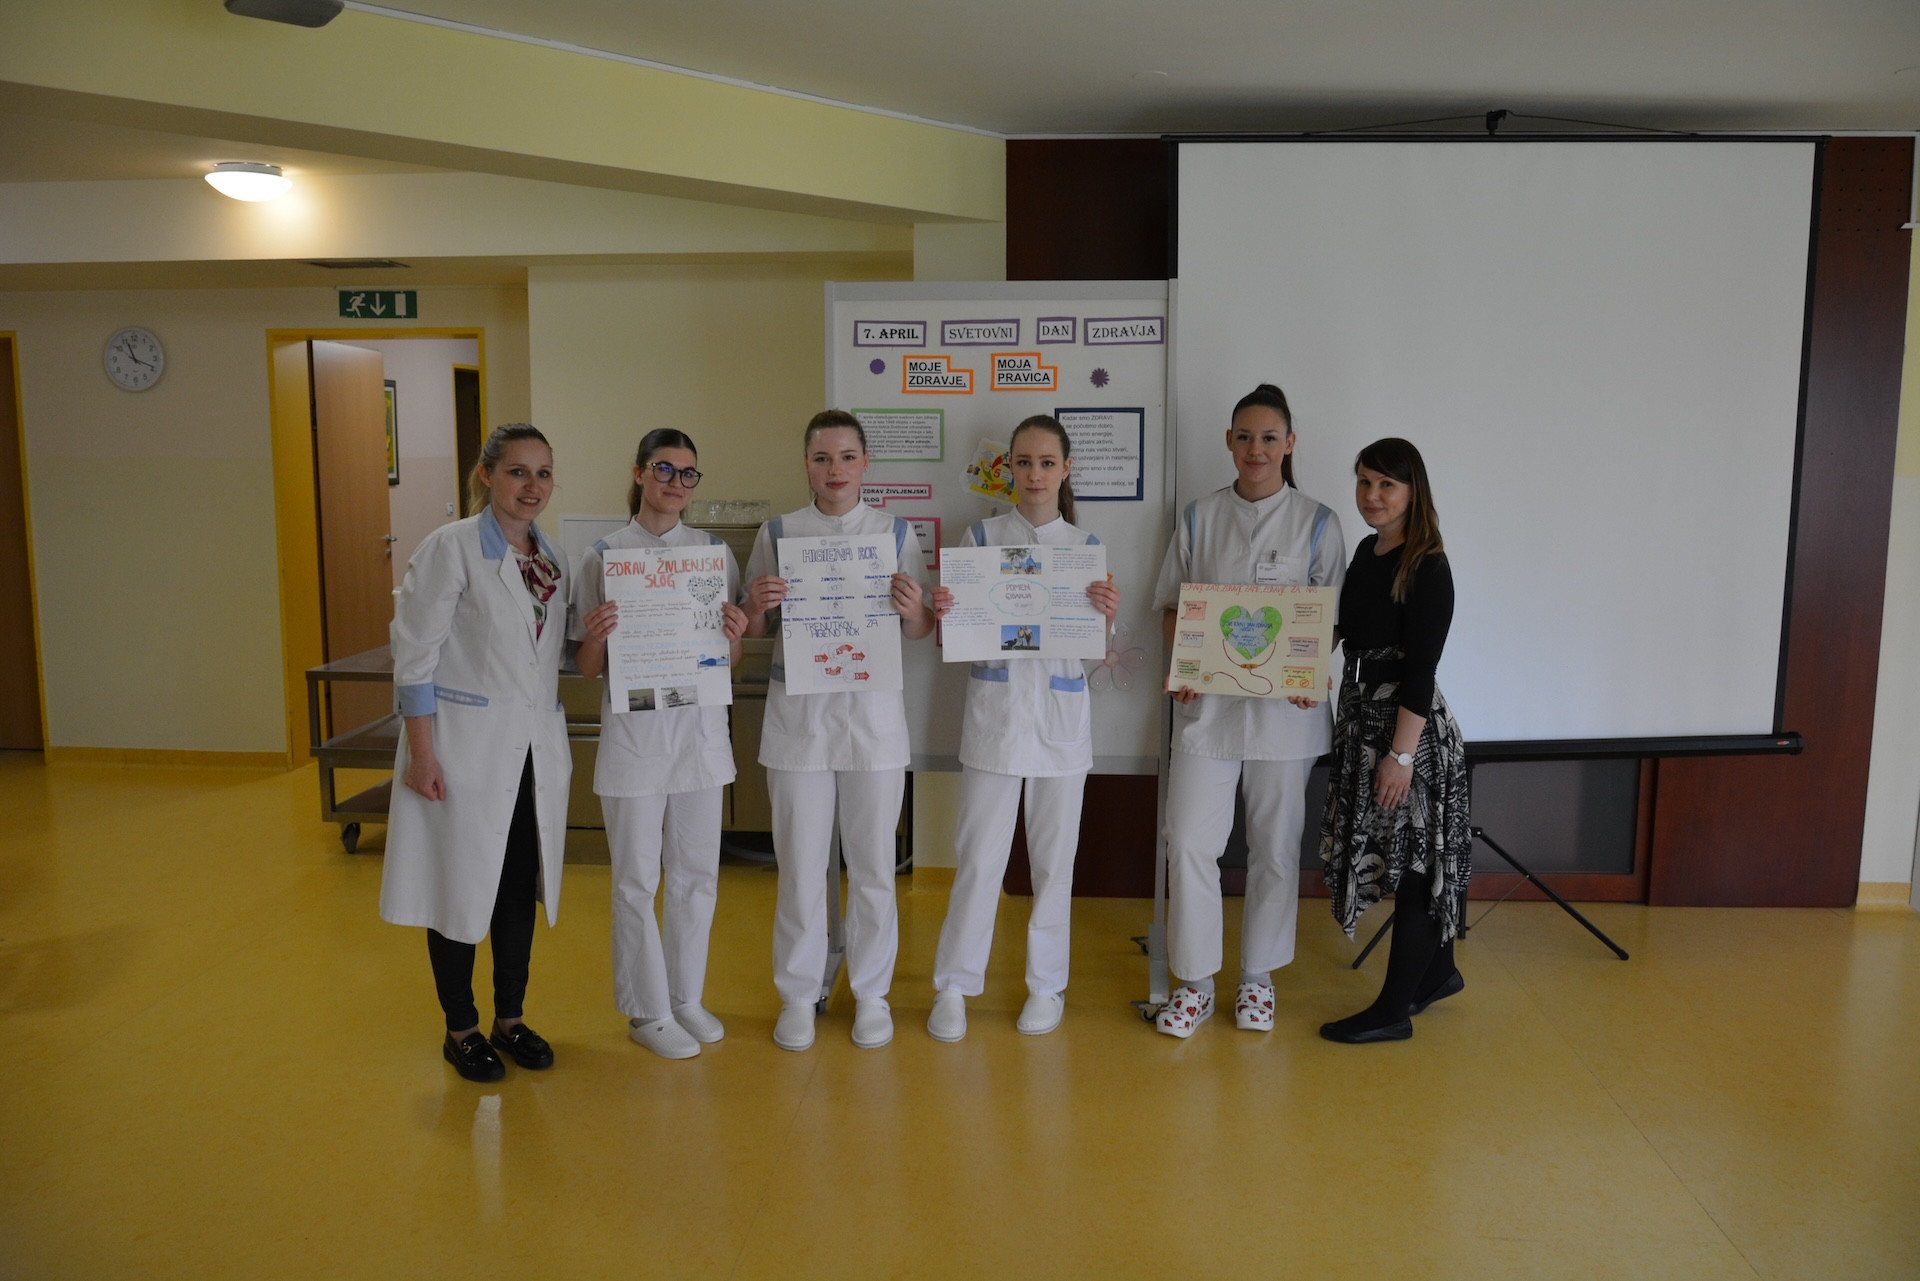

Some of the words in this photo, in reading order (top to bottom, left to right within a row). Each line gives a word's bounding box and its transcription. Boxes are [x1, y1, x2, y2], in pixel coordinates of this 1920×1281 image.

[863, 328, 875, 339] 7.
[878, 328, 919, 339] APRIL
[948, 326, 1013, 339] SVETOVNI
[1041, 324, 1070, 337] DAN
[1092, 324, 1157, 339] ZDRAVJA
[908, 361, 942, 372] MOJE
[997, 358, 1031, 370] MOJA
[908, 374, 967, 387] ZDRAVJE,
[997, 371, 1051, 384] PRAVICA
[885, 487, 927, 495] ŽIVLJENJSKI
[802, 548, 854, 563] HIGIENA
[857, 546, 878, 561] ROK
[605, 561, 646, 577] ZDRAV
[656, 557, 725, 575] ŽIVLJENJSKI
[644, 574, 676, 590] SLOG
[1006, 583, 1031, 591] POMEN
[866, 618, 879, 629] ZA
